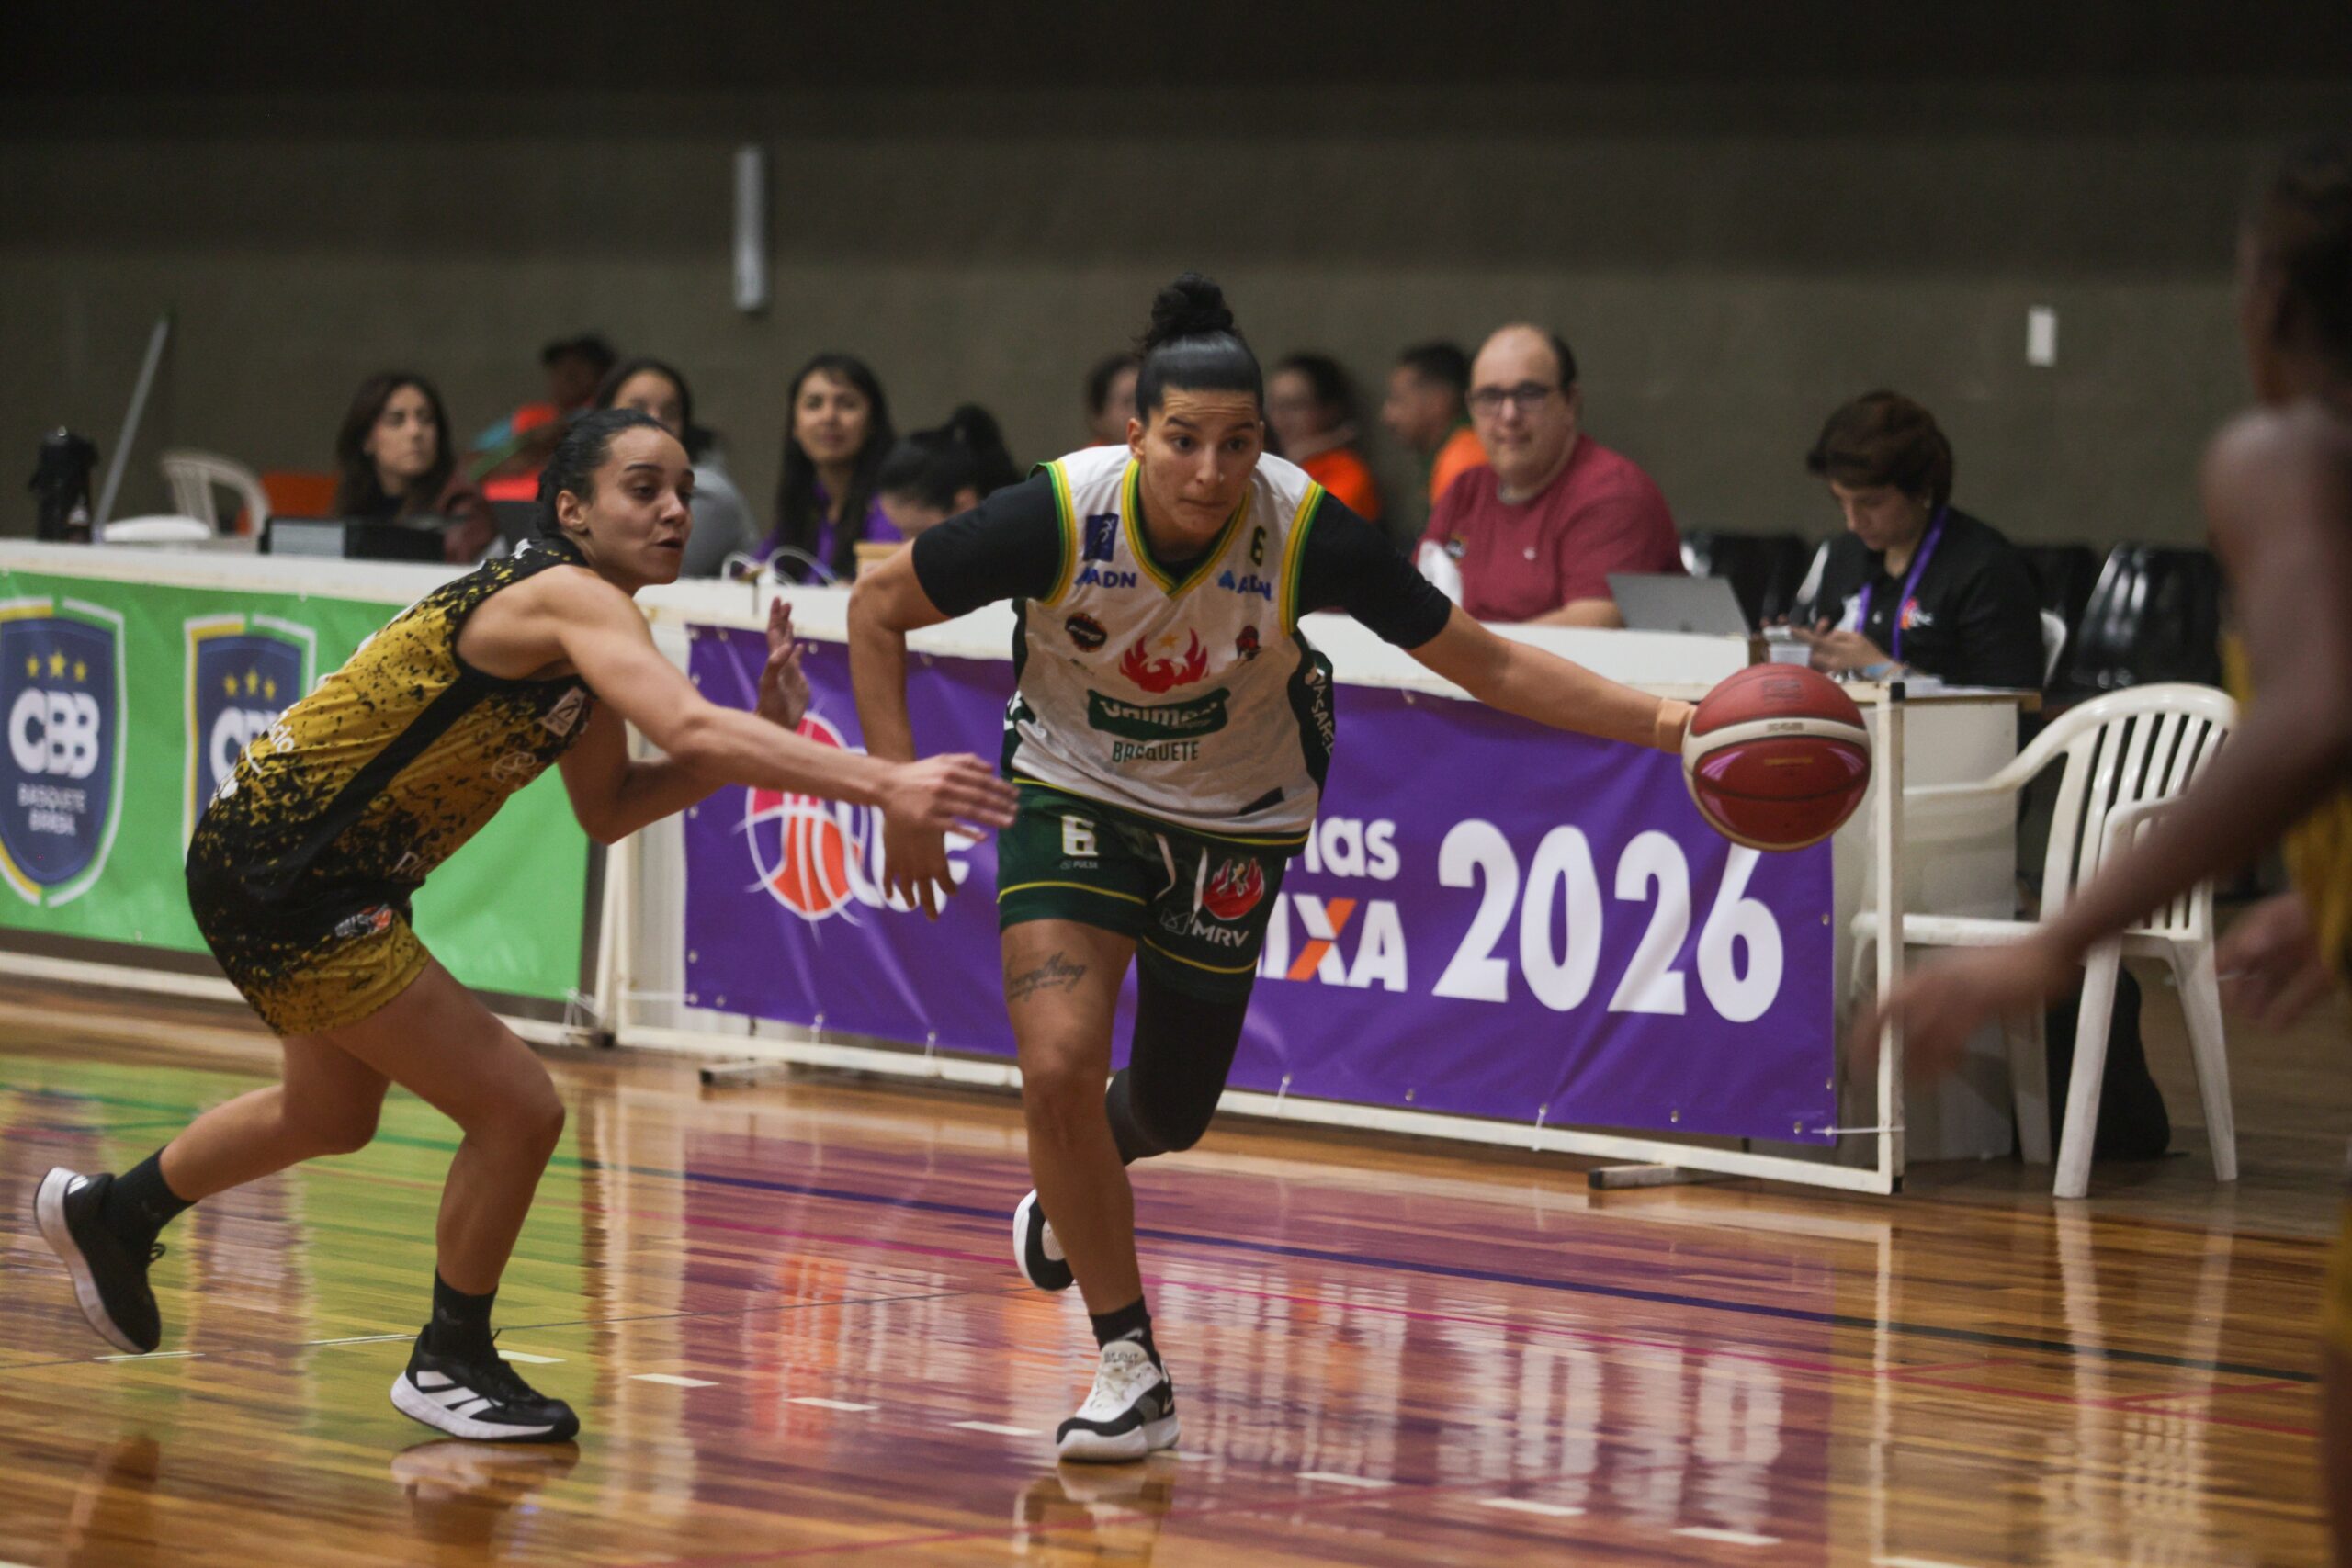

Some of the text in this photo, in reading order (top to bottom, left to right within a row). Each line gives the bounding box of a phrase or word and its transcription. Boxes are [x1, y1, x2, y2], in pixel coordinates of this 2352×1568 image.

[1250, 525, 1266, 567] 6
[1085, 568, 1137, 589] ADN
[8, 687, 101, 780] CBB
[1061, 815, 1099, 856] 6
[1192, 919, 1250, 948] MRV
[1430, 818, 1784, 1023] 2026
[1256, 891, 1408, 993] IXA
